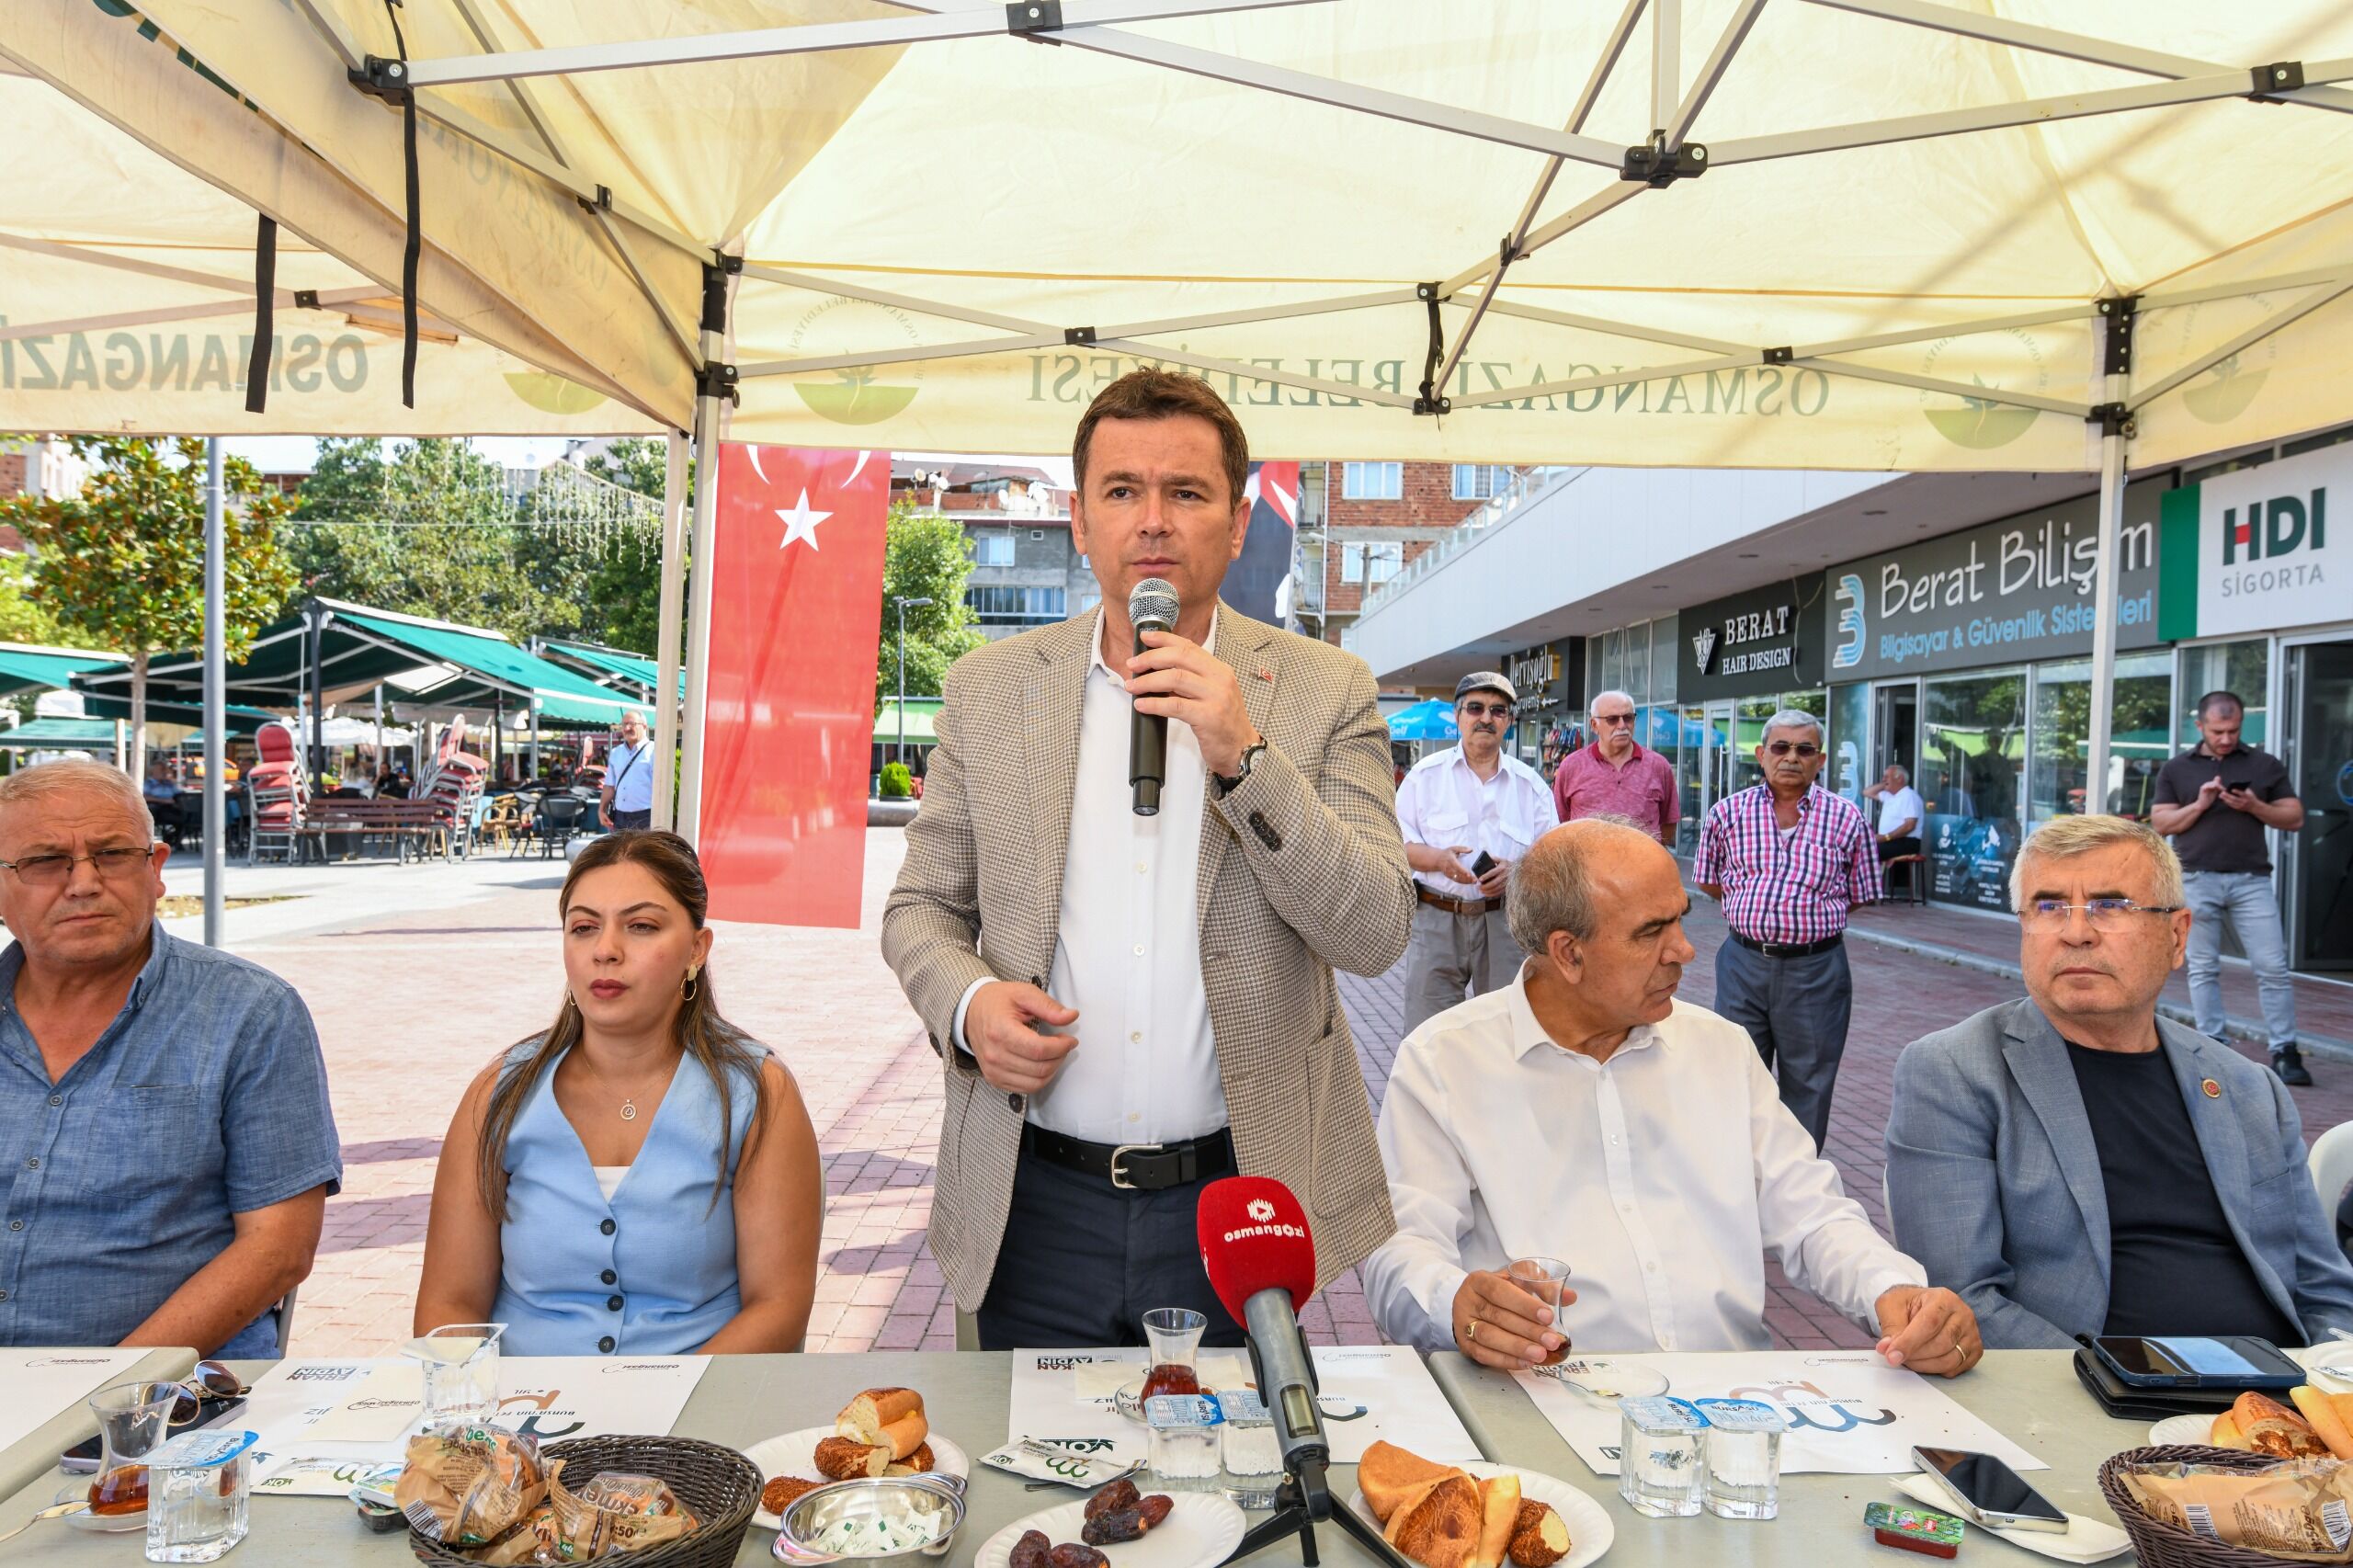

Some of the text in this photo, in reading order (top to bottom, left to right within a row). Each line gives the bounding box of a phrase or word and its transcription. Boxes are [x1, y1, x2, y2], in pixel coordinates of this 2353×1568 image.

[2222, 486, 2326, 566] HDI
[1881, 519, 2153, 619] Berat Bilişm
[2222, 562, 2325, 598] SİGORTA
[1724, 605, 1790, 646] BERAT
[1880, 589, 2153, 664] Bilgisayar & Güvenlik Sisteleri
[1722, 646, 1792, 676] HAIR DESIGN
